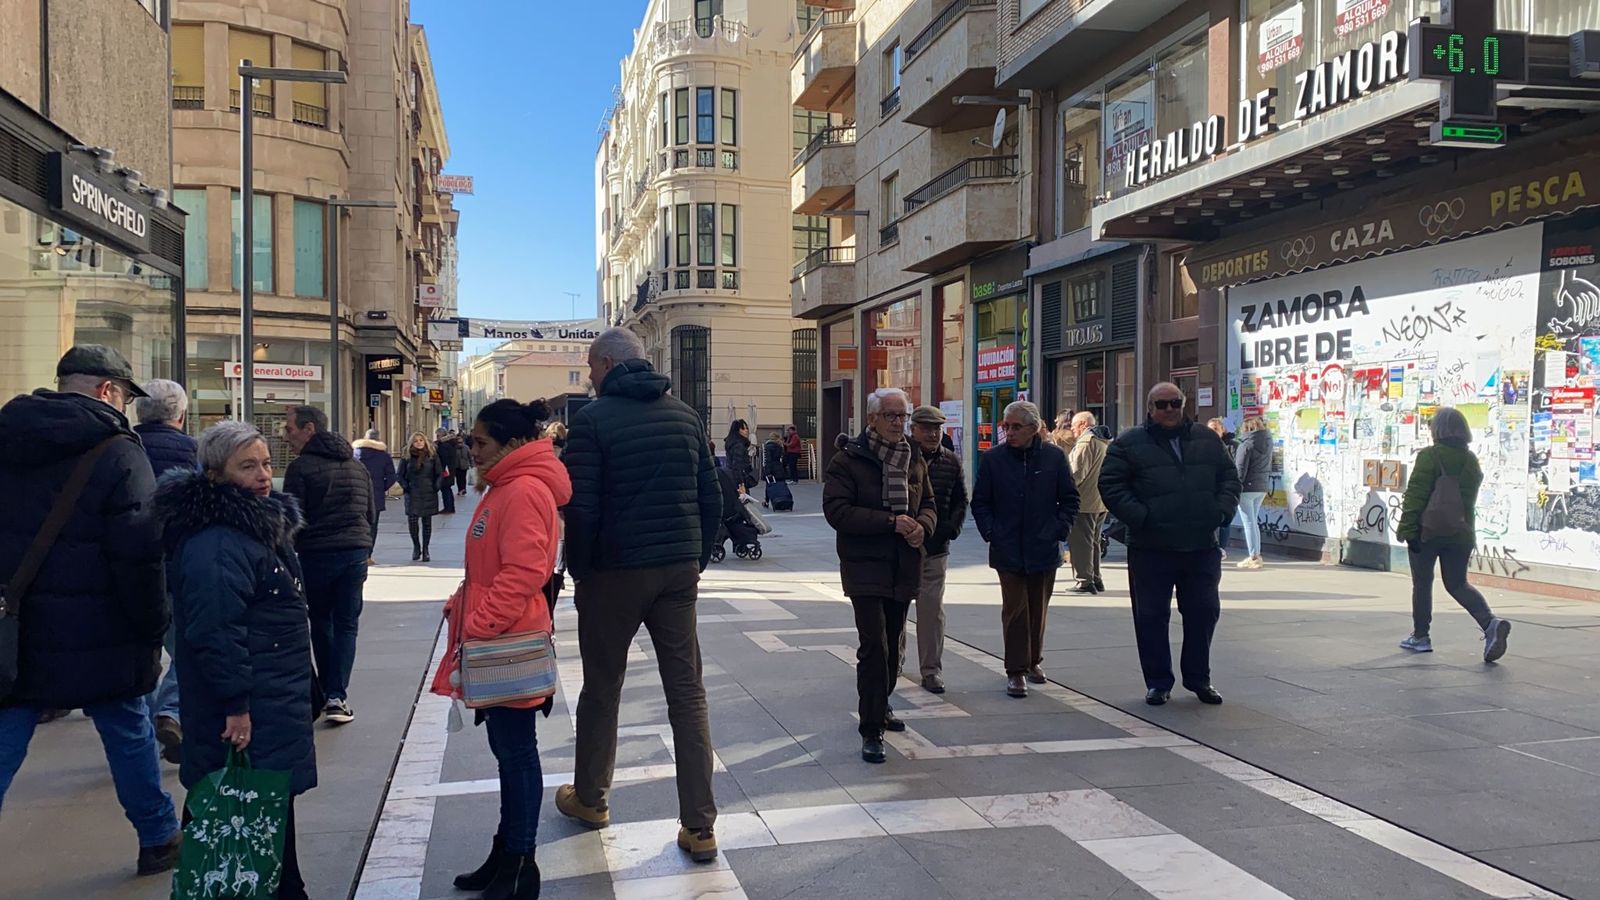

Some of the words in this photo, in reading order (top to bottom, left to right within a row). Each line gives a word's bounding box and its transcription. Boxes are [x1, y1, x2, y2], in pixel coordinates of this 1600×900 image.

[1340, 21, 1354, 35] 980
[1355, 12, 1369, 28] 531
[1372, 4, 1386, 20] 669
[1344, 0, 1382, 23] ALQUILA
[1265, 38, 1296, 60] ALQUILA
[1261, 61, 1273, 73] 980
[1274, 54, 1287, 67] 531
[1125, 115, 1219, 187] HERALDO
[1238, 88, 1270, 142] DE
[1294, 30, 1409, 120] ZAMOR
[1111, 132, 1149, 160] ALQUILA
[72, 174, 146, 238] SPRINGFIELD
[1202, 249, 1269, 284] DEPORTES
[1330, 218, 1395, 253] CAZA
[1490, 171, 1586, 217] PESCA
[1549, 254, 1595, 267] SOBONES
[1241, 285, 1370, 334] ZAMORA
[484, 328, 527, 339] Manos
[558, 328, 600, 339] Unidas
[1066, 324, 1103, 347] TOUS
[978, 346, 1015, 367] LIQUIDACIÓN
[1240, 334, 1309, 369] LIBRE
[1315, 329, 1353, 362] DE
[254, 367, 283, 377] eneral
[285, 367, 314, 378] Optica
[978, 370, 989, 380] TOTAL
[989, 369, 997, 378] POR
[998, 365, 1015, 378] CIERRE
